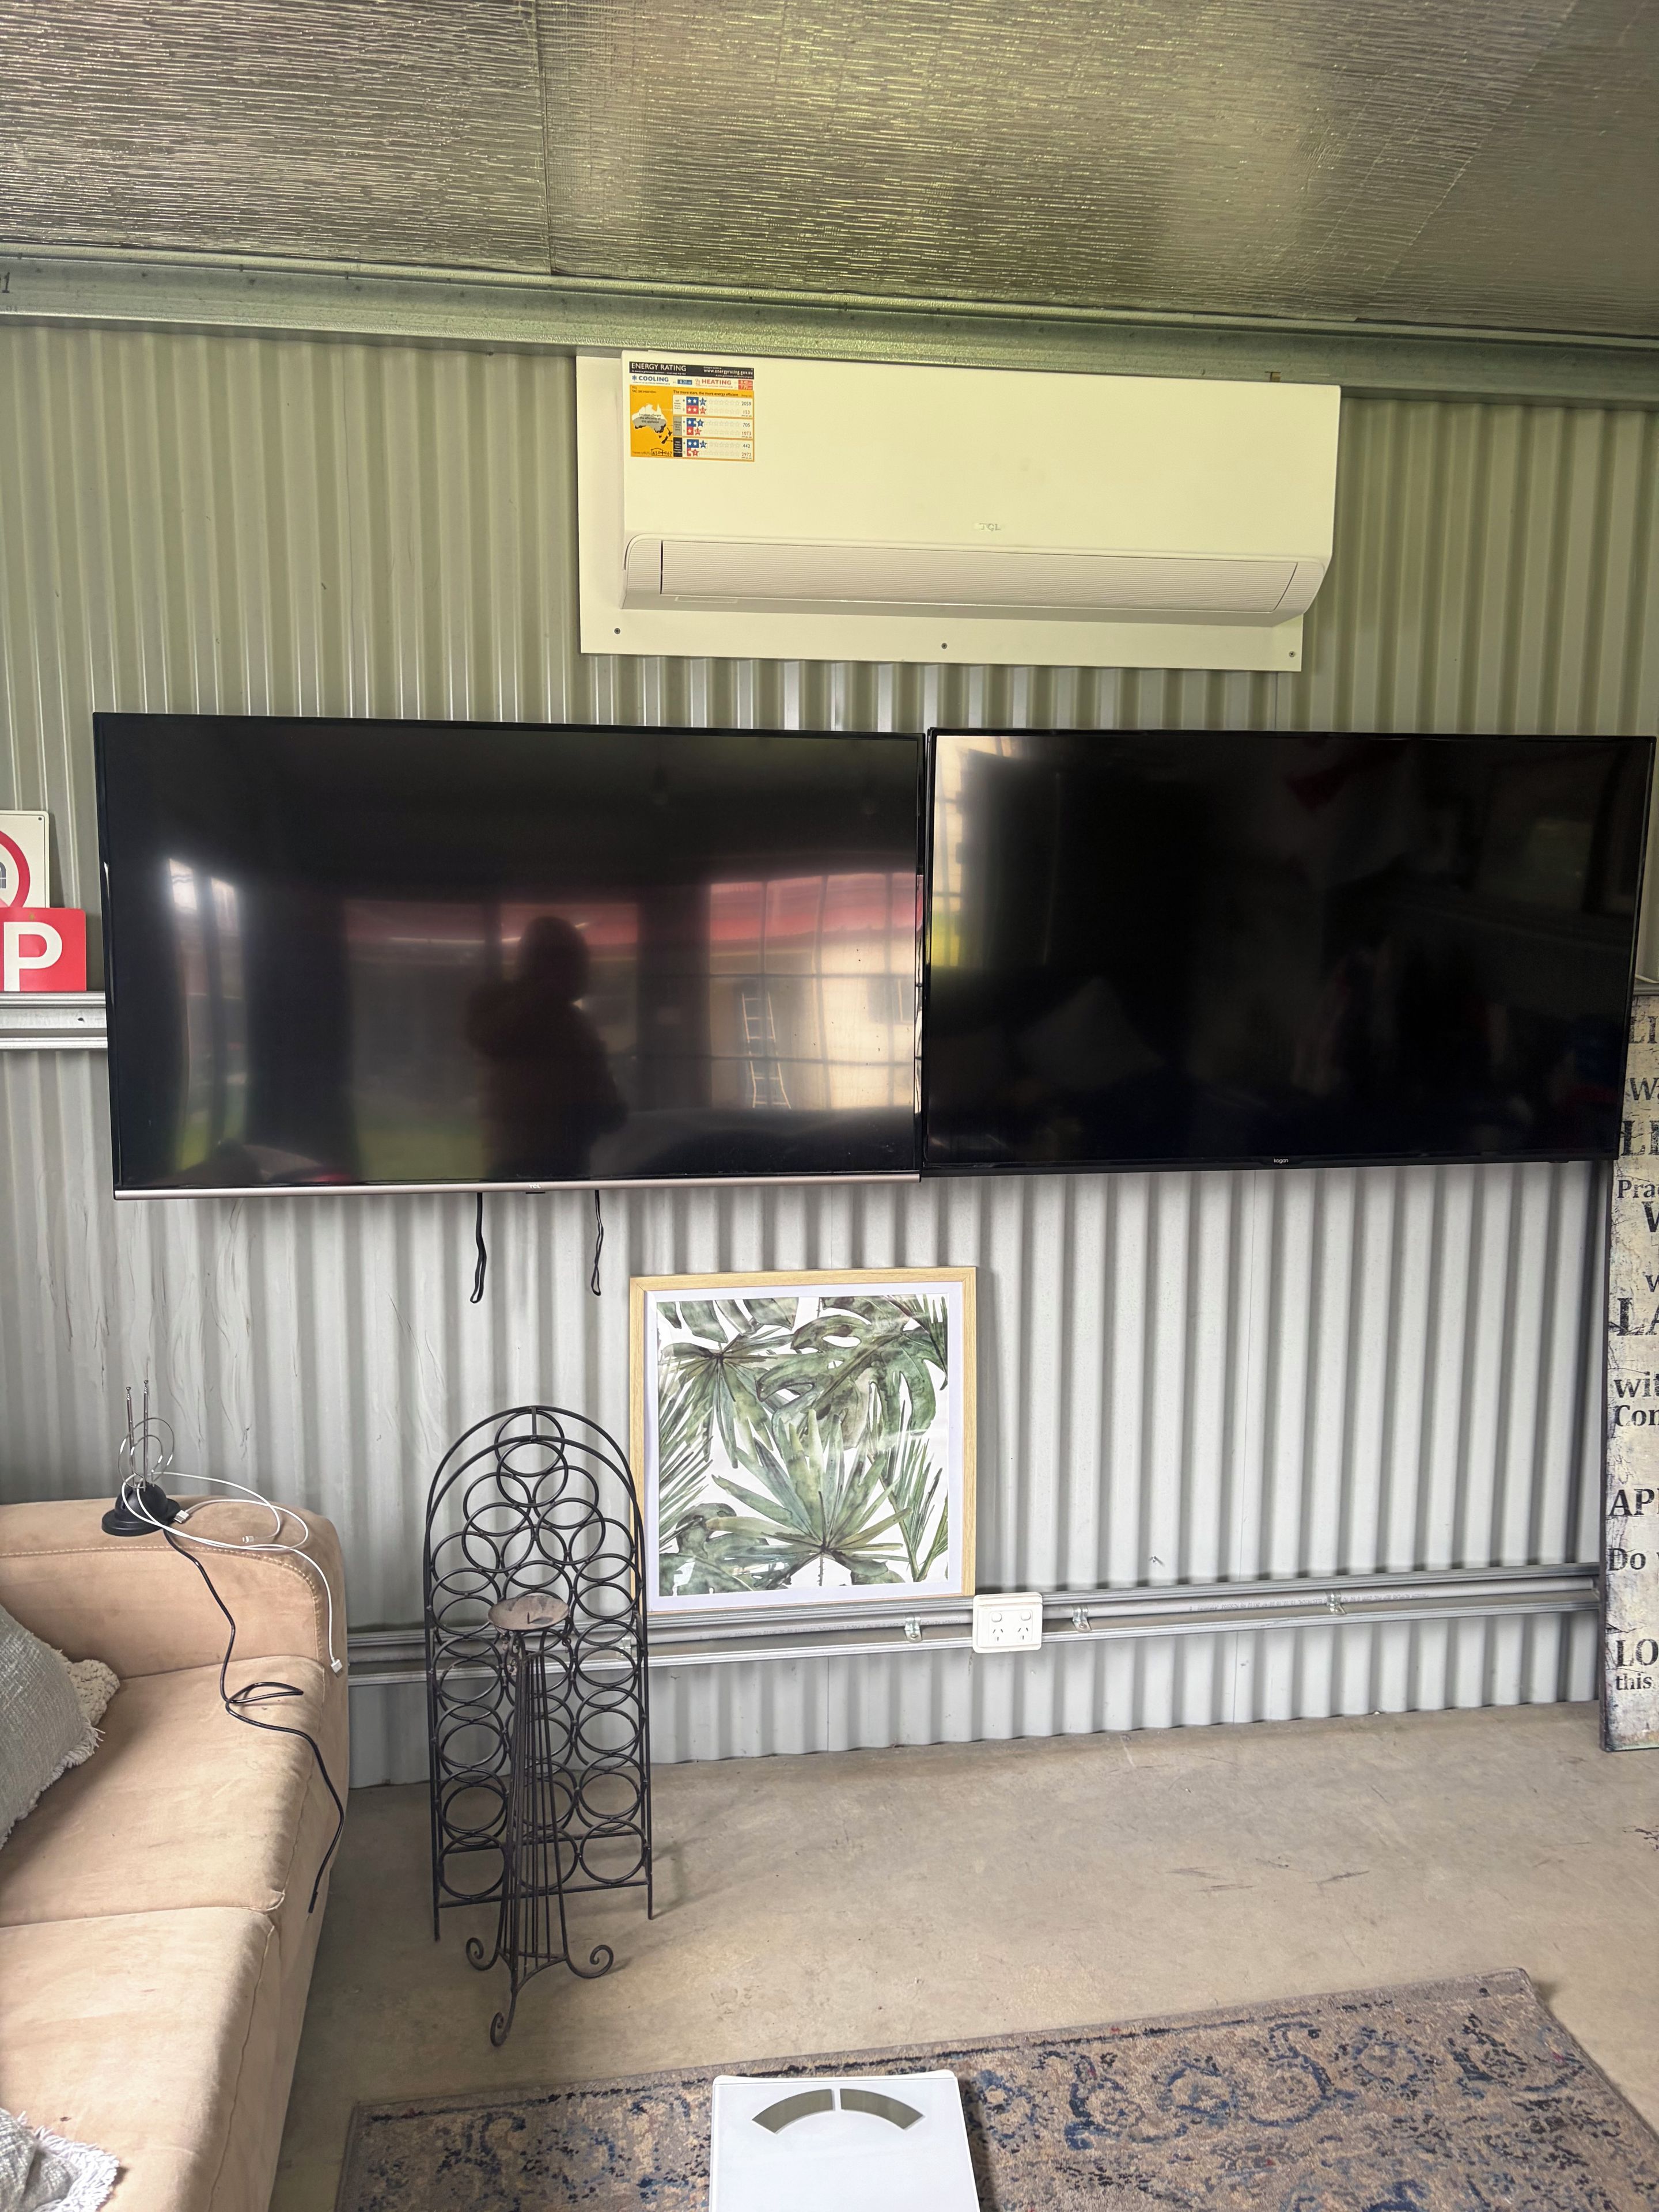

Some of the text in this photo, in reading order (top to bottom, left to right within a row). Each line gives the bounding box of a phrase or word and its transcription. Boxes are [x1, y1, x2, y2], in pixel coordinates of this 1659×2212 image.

[660, 363, 687, 372] RATING
[979, 522, 1002, 531] TCL
[3, 922, 63, 991] P
[1630, 1077, 1659, 1101] W
[1618, 1179, 1659, 1198] Pra
[1608, 1488, 1659, 1517] AP
[1608, 1548, 1646, 1571] Do
[1615, 1672, 1653, 1691] this
